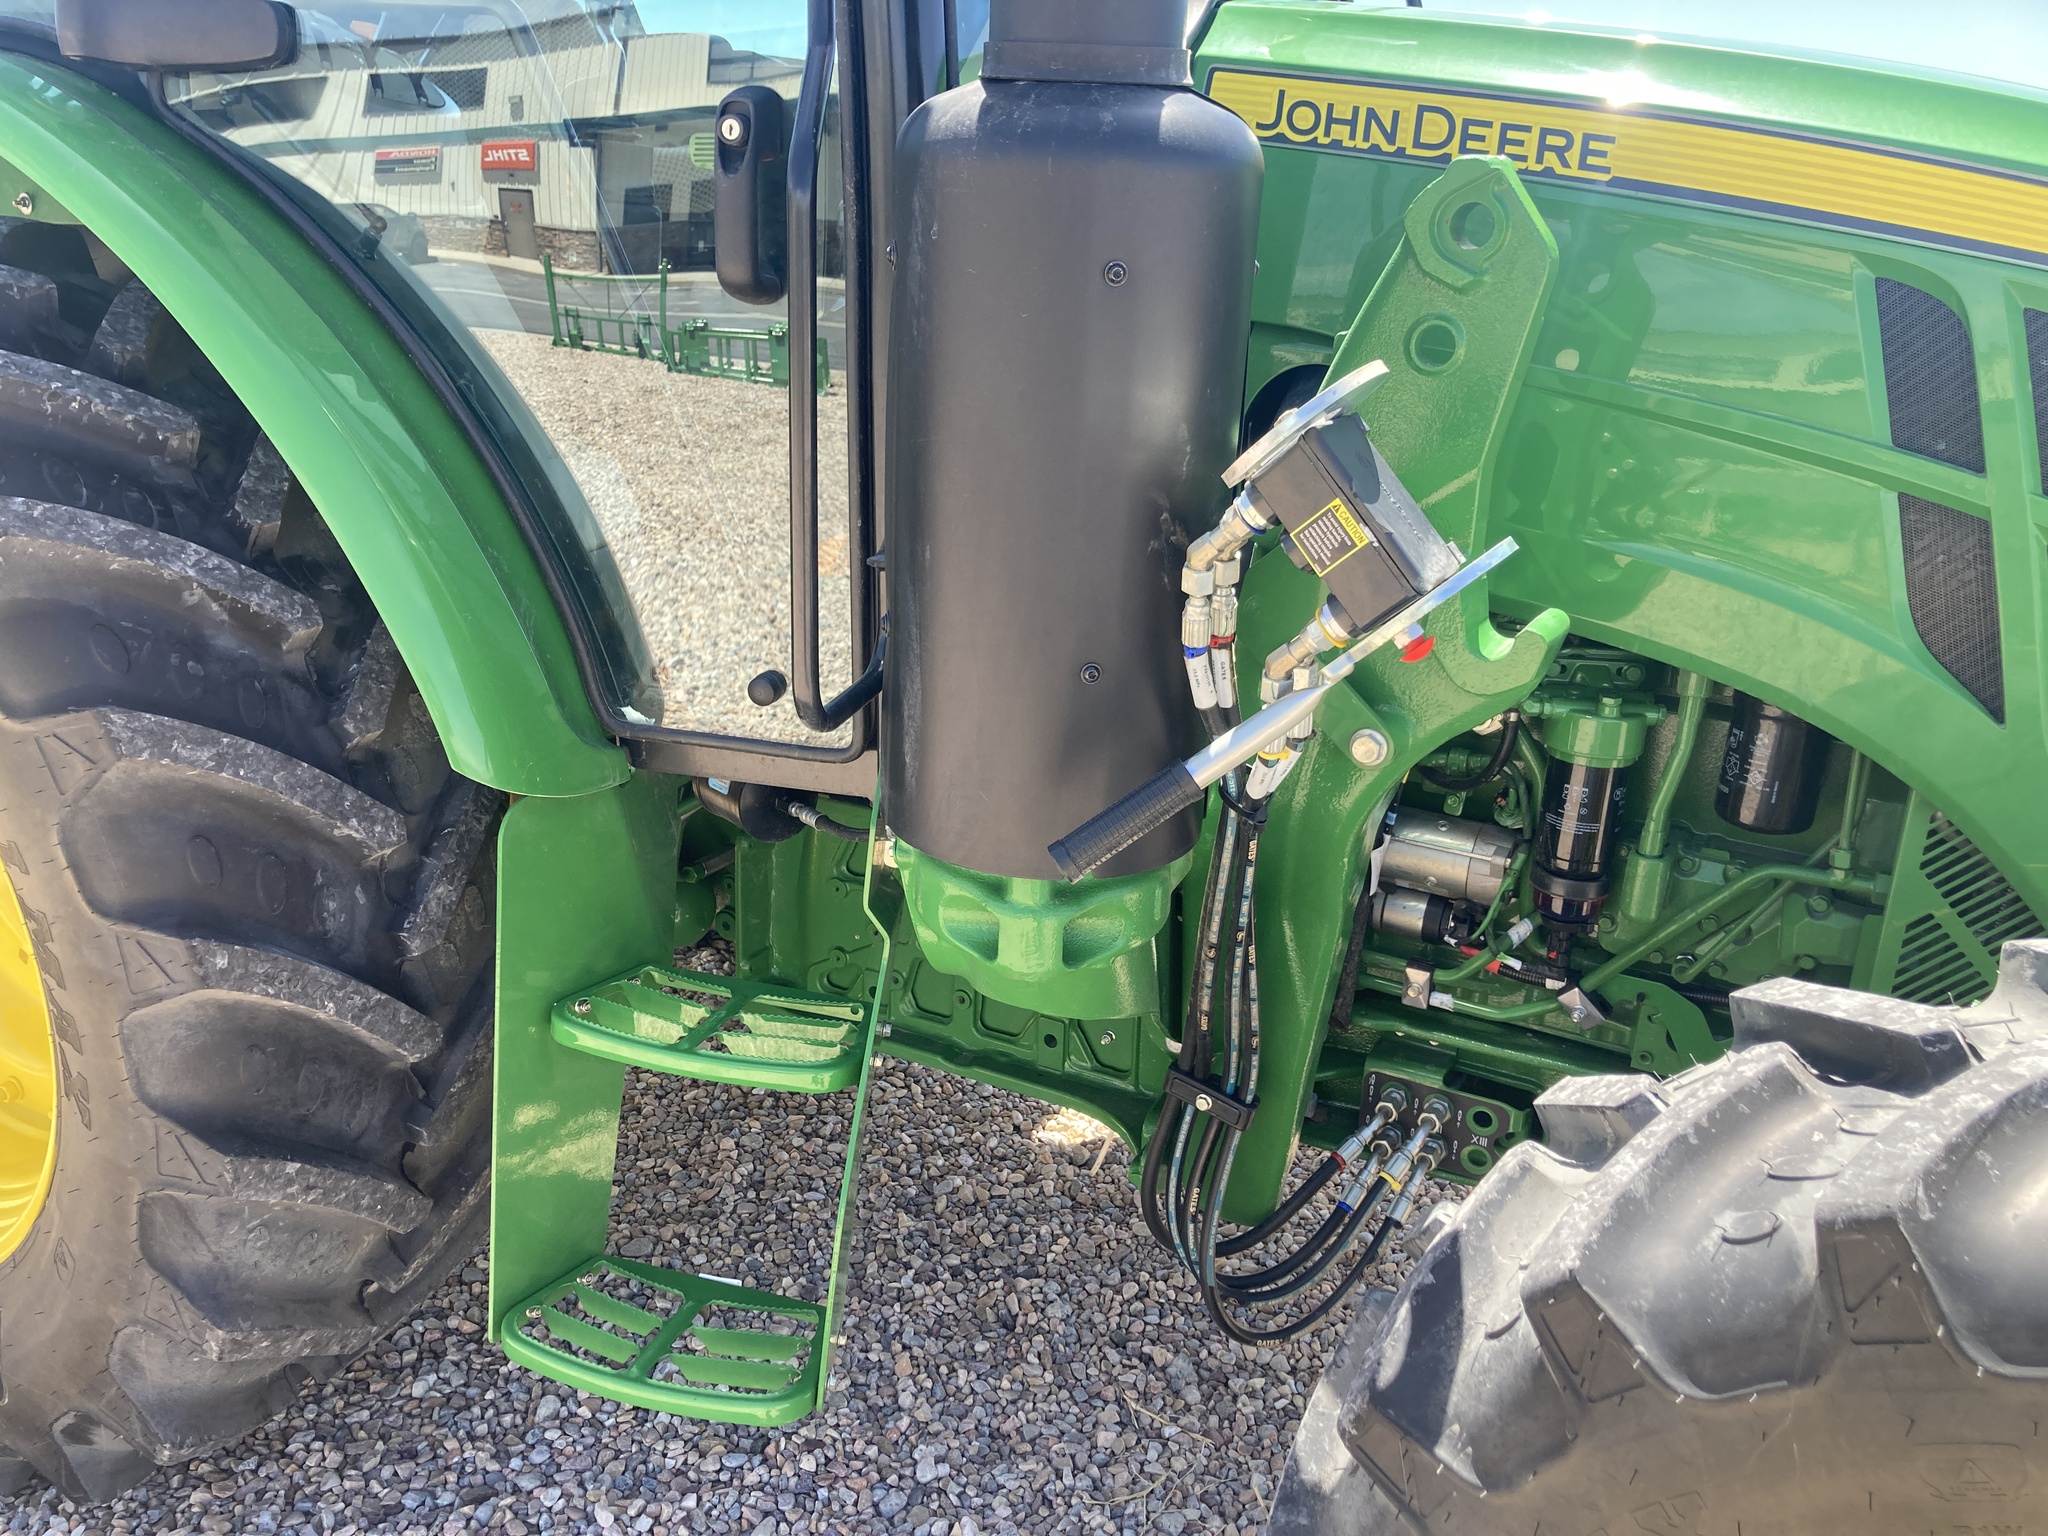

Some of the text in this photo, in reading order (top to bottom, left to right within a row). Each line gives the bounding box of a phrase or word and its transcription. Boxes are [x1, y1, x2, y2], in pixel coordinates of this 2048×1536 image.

[1256, 89, 1617, 176] JOHN DEERE
[1337, 510, 1365, 544] CAUTION
[1219, 661, 1227, 680] GATES
[1470, 1133, 1488, 1147] XIII
